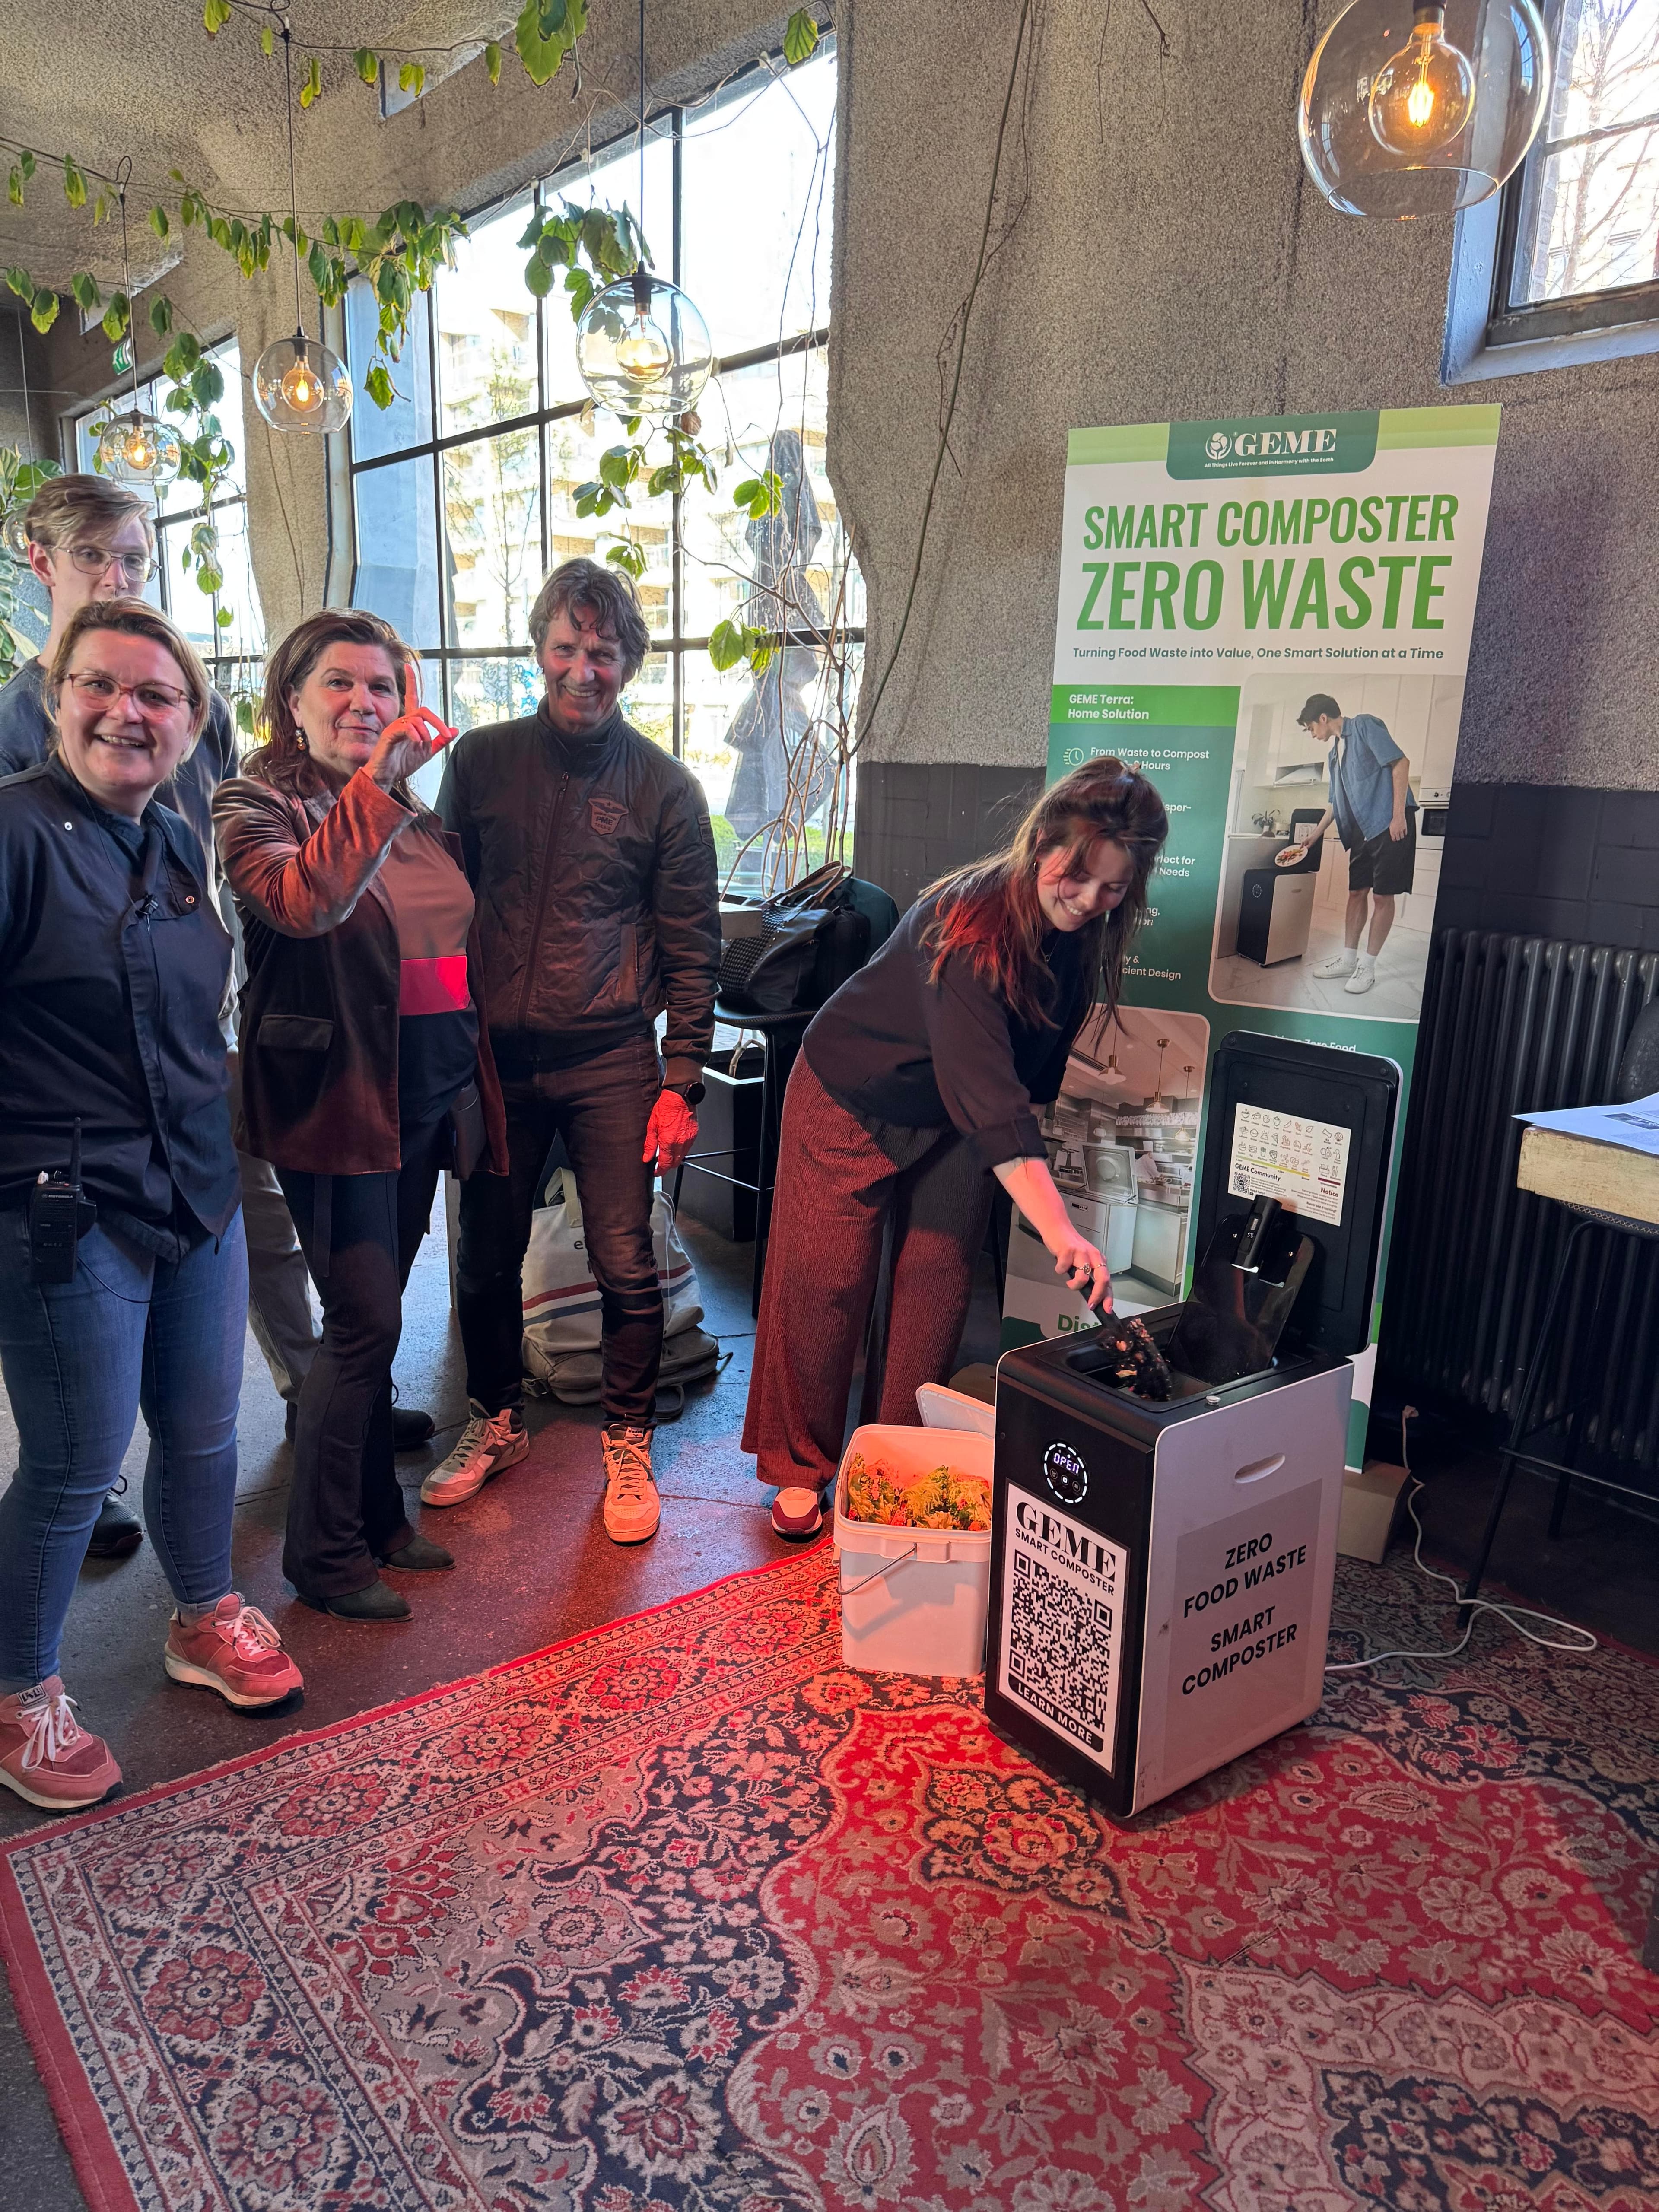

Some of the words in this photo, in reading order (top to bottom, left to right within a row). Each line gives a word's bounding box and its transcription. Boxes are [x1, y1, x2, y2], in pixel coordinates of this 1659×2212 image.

[1234, 429, 1337, 457] GEME
[1083, 502, 1208, 550] SMART
[1217, 494, 1459, 547] COMPOSTER
[1076, 559, 1224, 631] ZERO
[1243, 555, 1452, 630] WASTE
[1073, 647, 1116, 660] Turning
[1118, 648, 1147, 657] Food
[1150, 648, 1187, 658] Waste
[1189, 647, 1214, 658] into
[1217, 648, 1254, 660] Value,
[1257, 648, 1281, 658] One
[1284, 648, 1323, 658] Smart
[1325, 647, 1379, 658] Solution
[1382, 648, 1396, 658] at
[1410, 647, 1444, 658] Time
[1069, 694, 1098, 704] GEME
[1100, 695, 1134, 704] Terra:
[1068, 709, 1100, 718] Home
[1102, 709, 1149, 719] Solution
[1090, 747, 1115, 756] From
[1118, 748, 1148, 757] Waste
[1151, 749, 1161, 757] to
[1163, 750, 1209, 760] Compost
[1141, 761, 1170, 770] Hours
[1165, 804, 1191, 814] sper-
[1181, 856, 1195, 865] for
[1159, 867, 1190, 877] Needs
[1122, 966, 1146, 976] cient
[1148, 969, 1181, 981] Design
[1235, 1163, 1250, 1172] GEME
[1250, 1167, 1281, 1182] Community
[1321, 1187, 1338, 1197] Notice
[1054, 1453, 1079, 1474] OPEN
[1017, 1502, 1116, 1582] GEME
[1225, 1533, 1272, 1570] ZERO
[1016, 1528, 1049, 1554] SMART
[1051, 1550, 1114, 1595] COMPOSTER
[1184, 1578, 1238, 1618] FOOD
[1244, 1545, 1306, 1589] WASTE
[1211, 1605, 1275, 1652] SMART
[1182, 1624, 1297, 1695] COMPOSTER
[1018, 1683, 1054, 1717] LEARN
[1058, 1712, 1092, 1744] MORE
